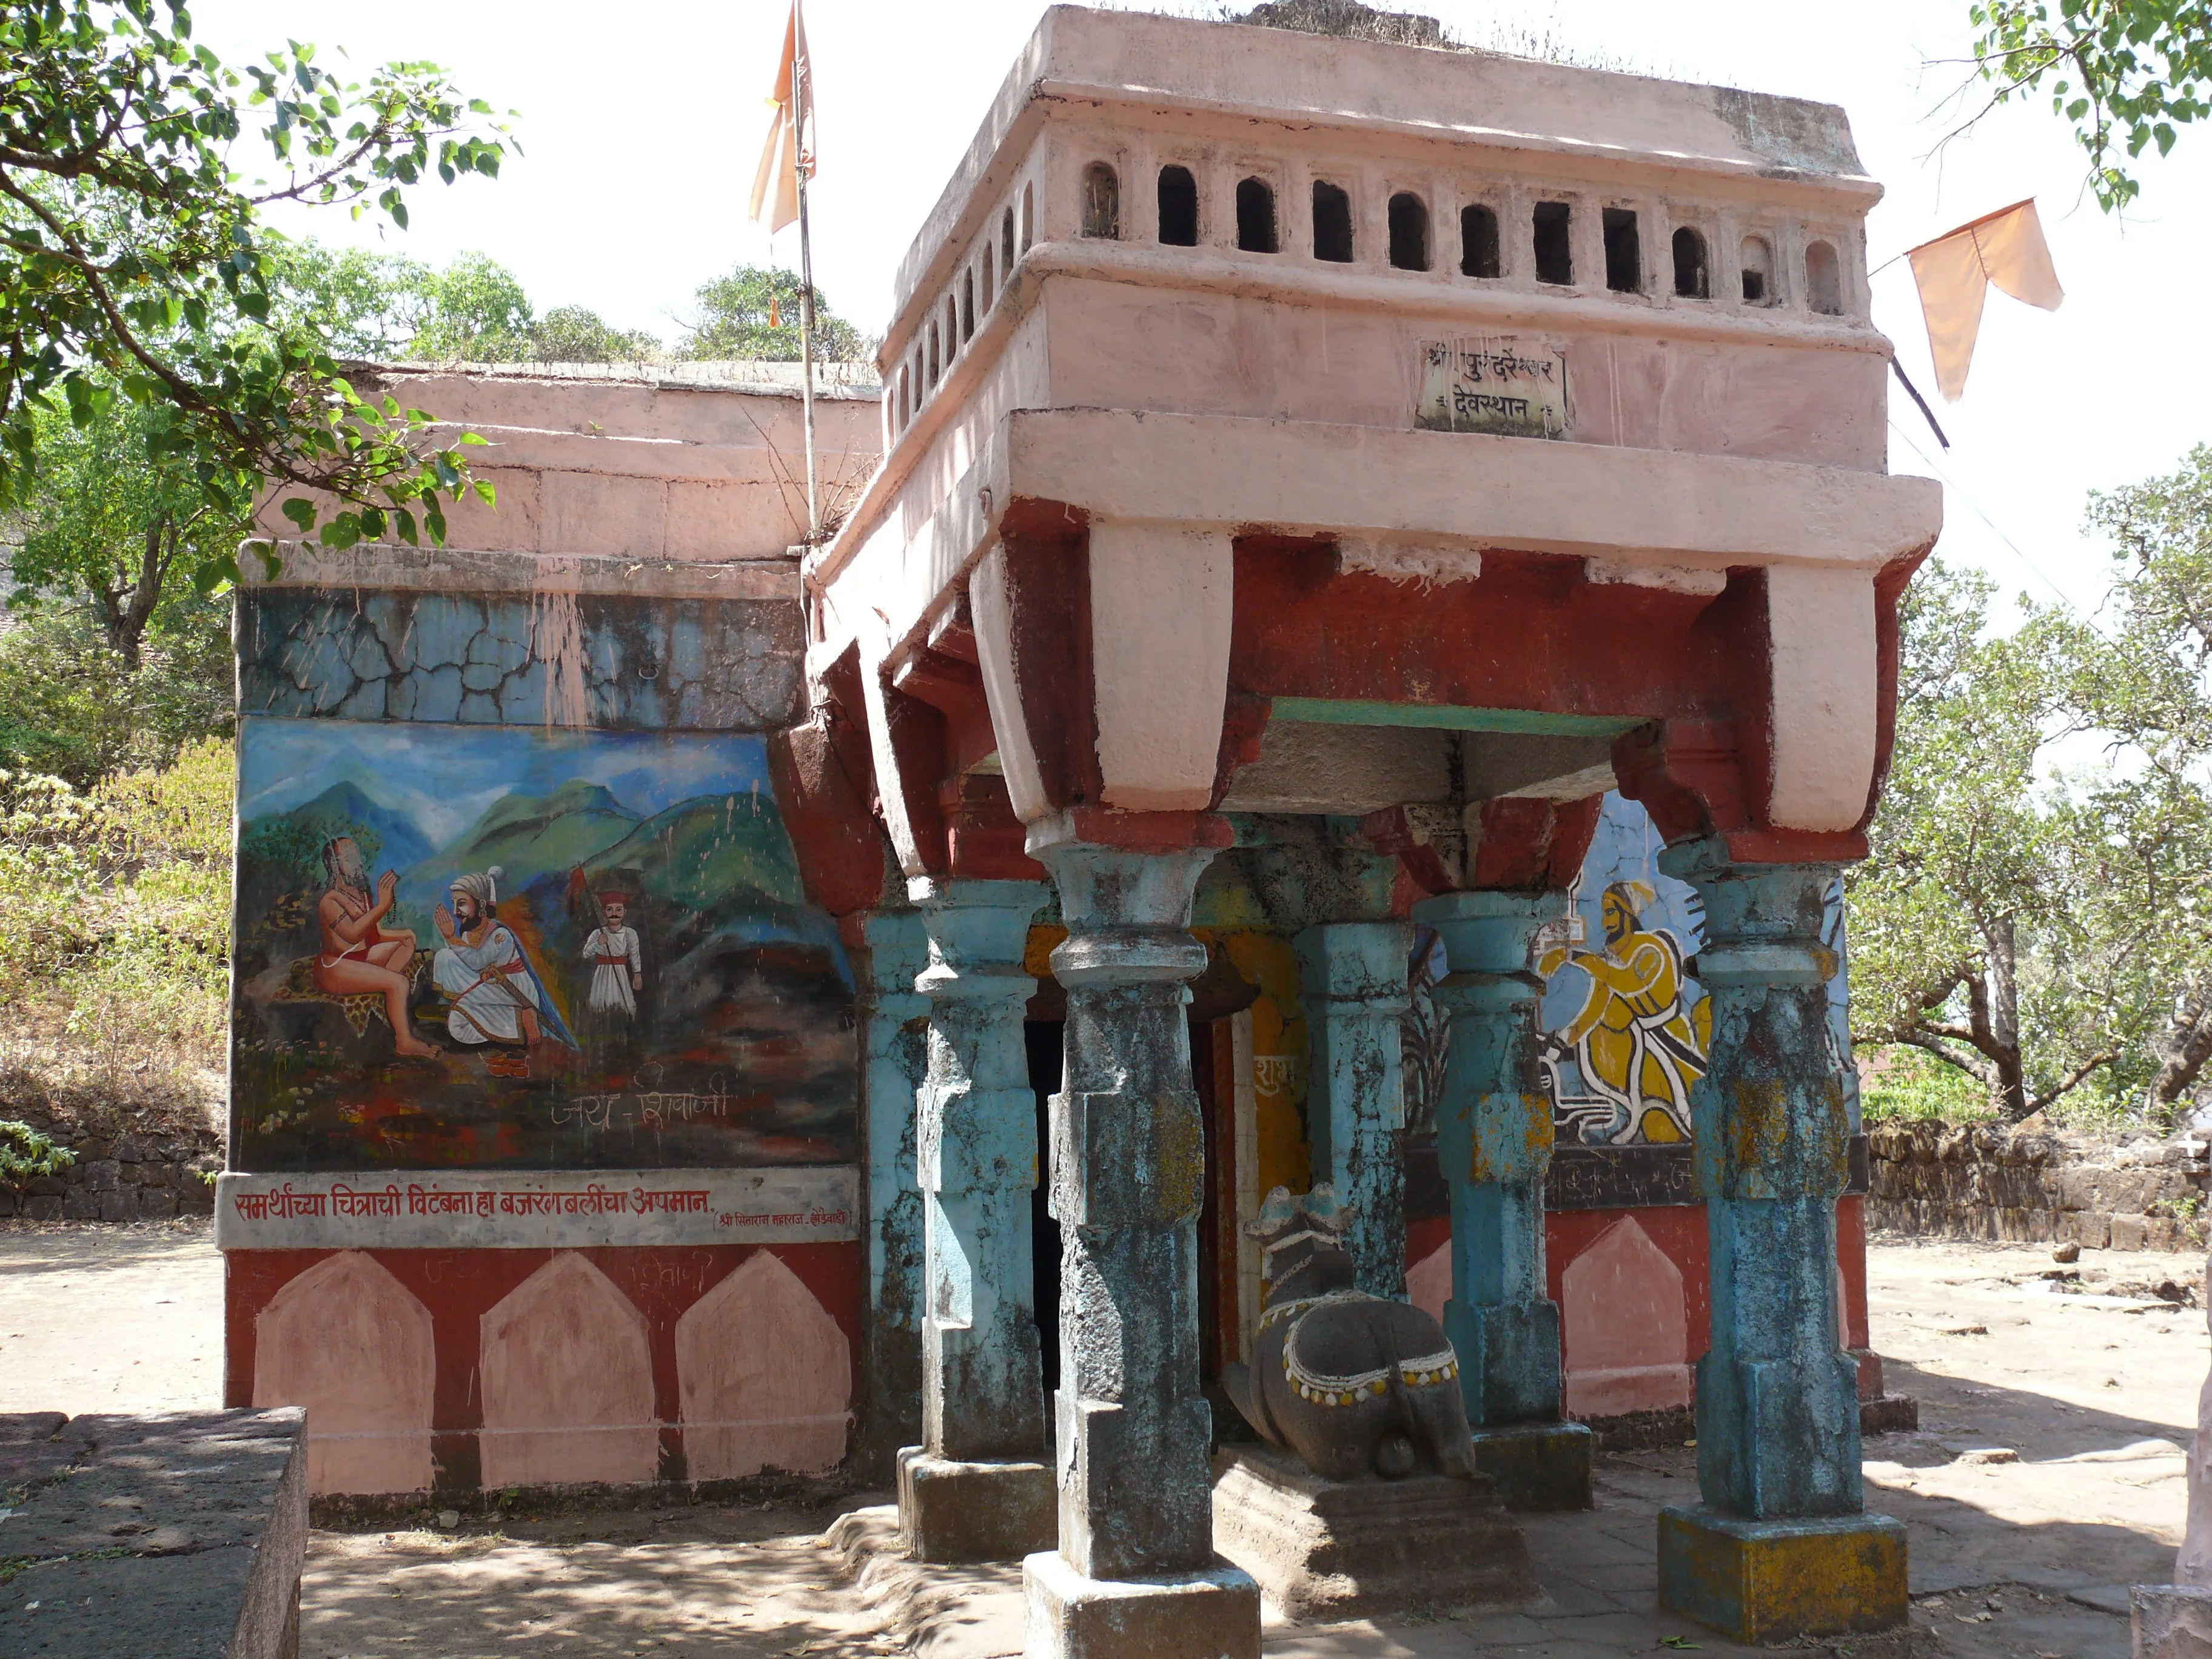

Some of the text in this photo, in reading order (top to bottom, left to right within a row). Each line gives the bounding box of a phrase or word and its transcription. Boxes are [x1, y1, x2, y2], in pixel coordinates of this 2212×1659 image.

[1453, 384, 1529, 421] देवस्थान
[234, 1182, 327, 1222] समर्थांच्या
[330, 1183, 403, 1217] चित्राची
[406, 1183, 474, 1216] विटंबना
[475, 1191, 497, 1218] हा
